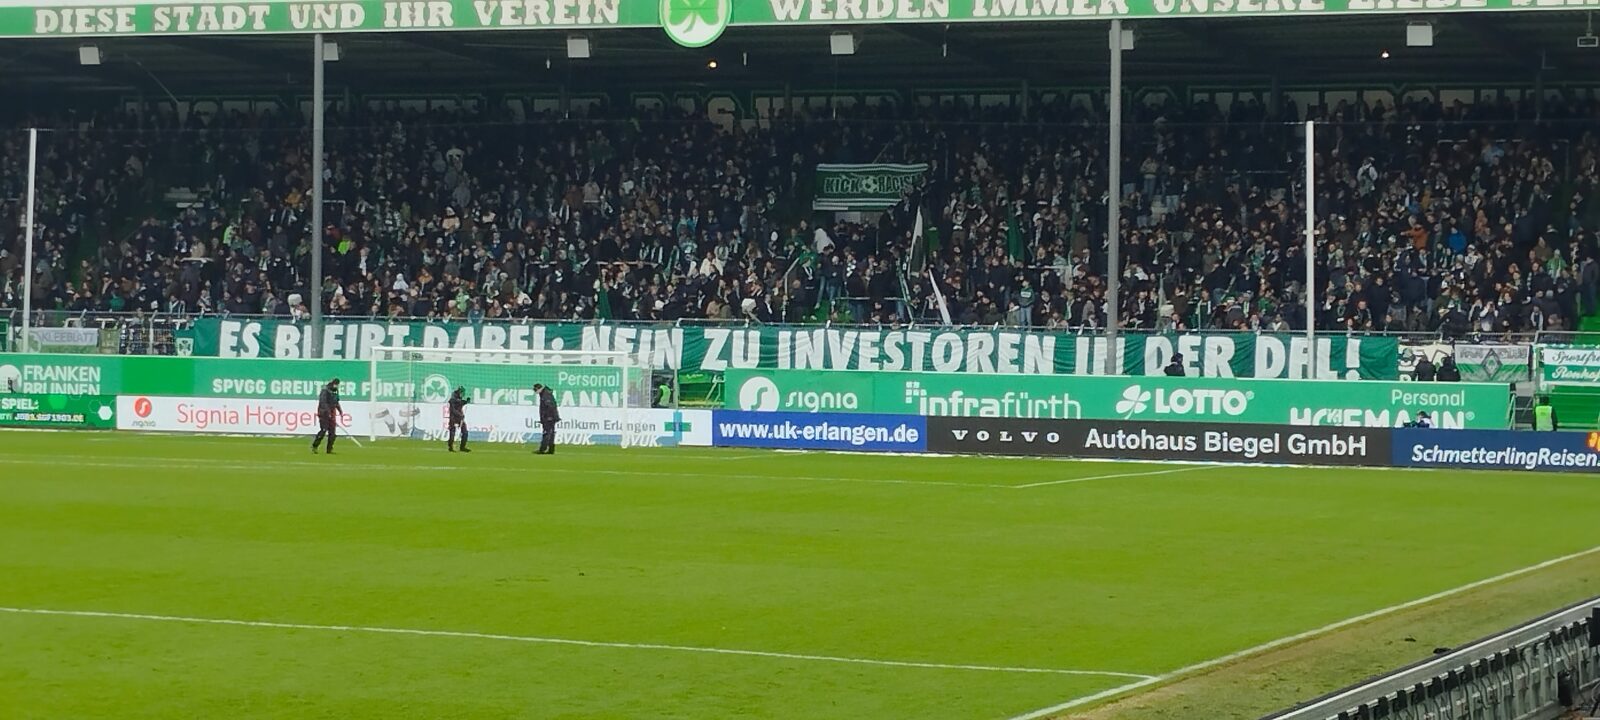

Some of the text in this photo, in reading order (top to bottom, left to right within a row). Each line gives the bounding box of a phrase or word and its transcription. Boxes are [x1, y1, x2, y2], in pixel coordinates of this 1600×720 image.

[35, 8, 136, 34] DIESE
[154, 5, 270, 31] STADT
[289, 2, 366, 29] UND
[384, 1, 454, 28] IHR
[475, 0, 620, 26] VEREIN
[771, 0, 949, 21] WERDEN
[824, 177, 862, 194] KICK
[42, 332, 94, 345] KLEEBLATT
[219, 320, 261, 358] ES
[274, 323, 410, 361] BLEIBT
[580, 326, 684, 370] NEIN
[700, 328, 760, 370] ZU
[777, 329, 1056, 374] INVESTOREN
[1075, 336, 1125, 375] IN
[1144, 335, 1237, 379] DER
[1254, 335, 1361, 381] DFL!
[24, 365, 101, 382] FRANKEN
[558, 371, 619, 387] Personal
[213, 378, 266, 394] SPVGG
[271, 380, 356, 396] GREUTER
[785, 390, 858, 413] signia
[917, 391, 1081, 419] infrafürth
[1392, 389, 1465, 406] Personal
[177, 403, 239, 429] Signia
[719, 421, 918, 443] www.uk-erlangen.de
[951, 429, 1060, 443] VOLVO
[1085, 428, 1366, 458] Autohaus Biegel GmbH
